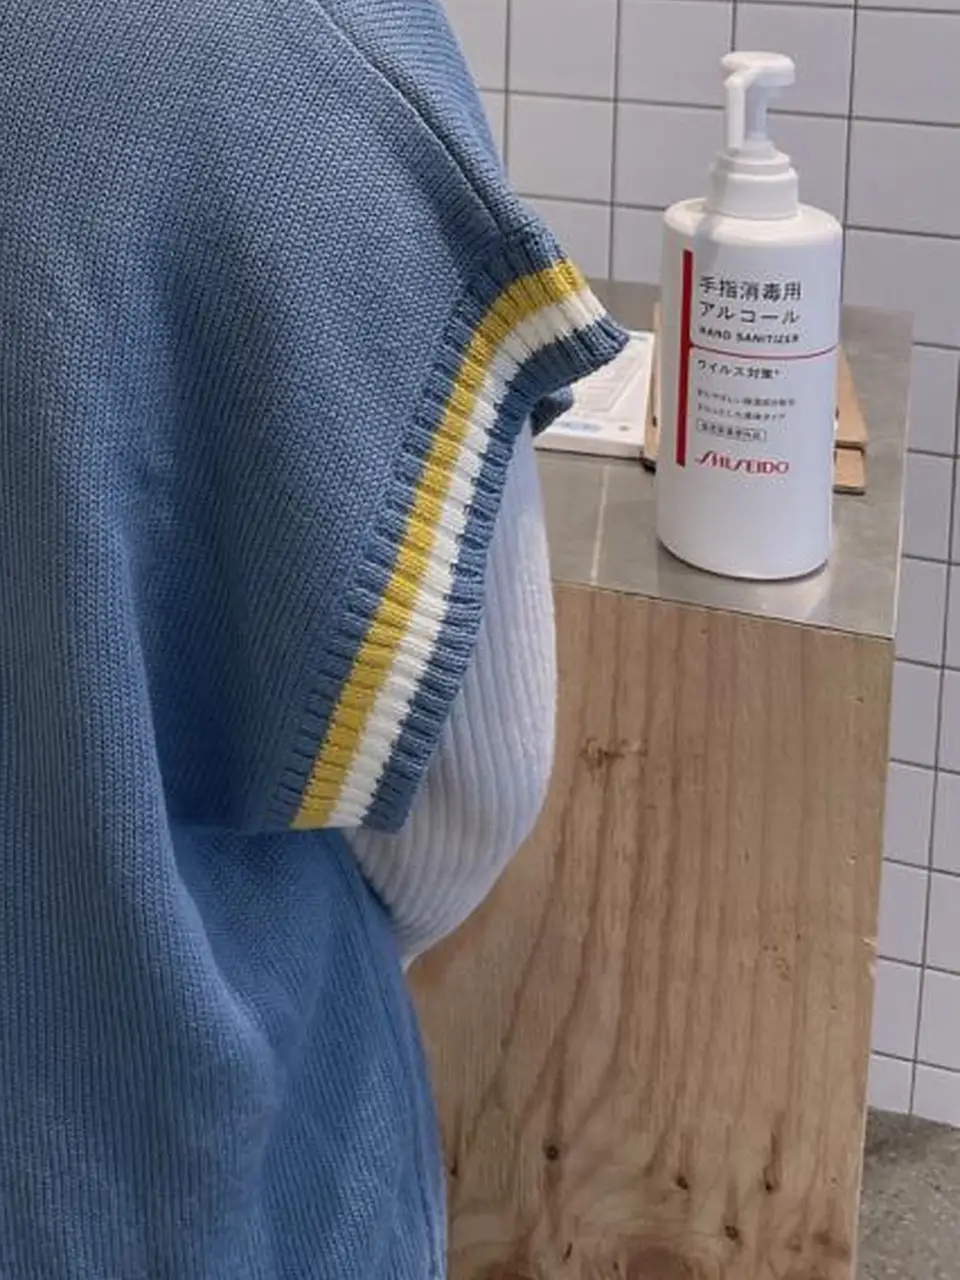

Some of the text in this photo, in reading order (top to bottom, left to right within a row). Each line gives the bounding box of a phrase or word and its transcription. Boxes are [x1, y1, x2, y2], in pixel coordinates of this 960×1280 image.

[698, 275, 802, 302] 手指消毒用
[699, 300, 800, 325] アルコール
[699, 324, 799, 344] HAND SANITIZER
[694, 449, 790, 474] SHISEIDO
